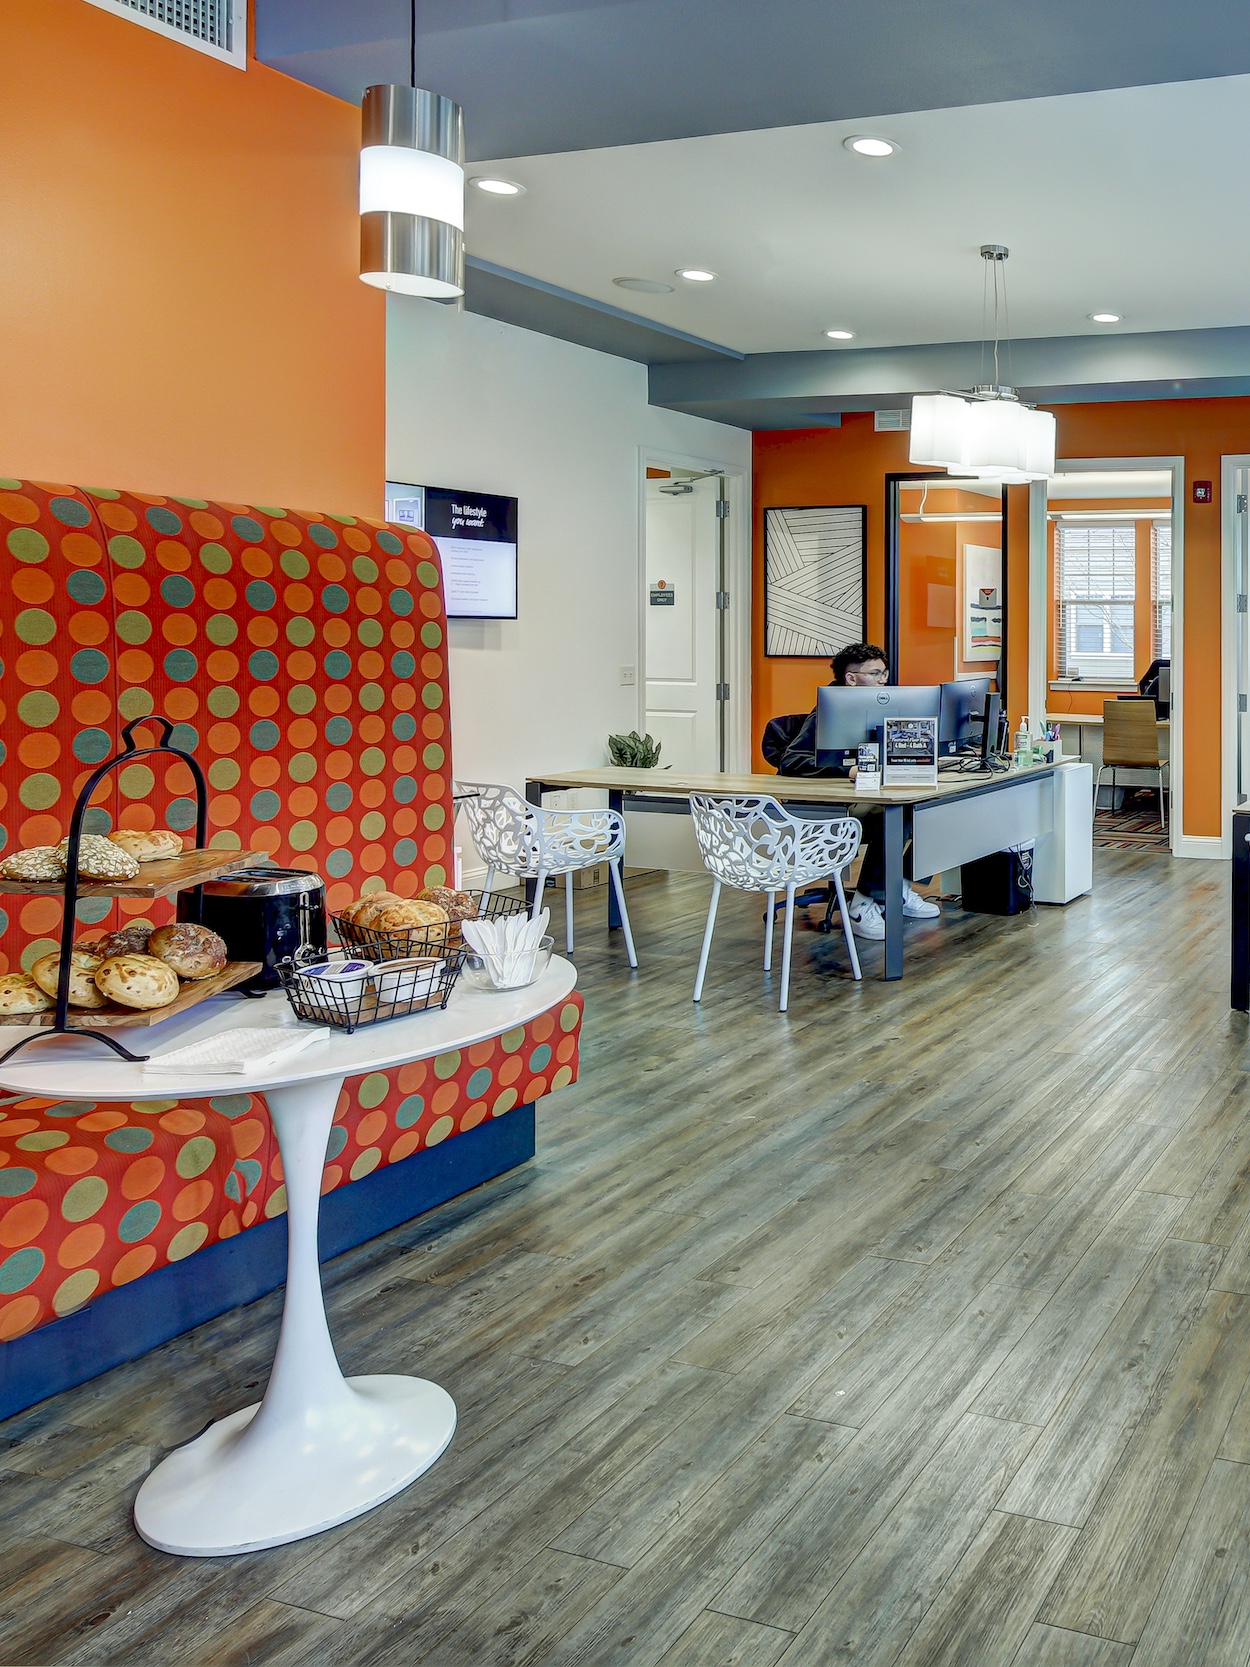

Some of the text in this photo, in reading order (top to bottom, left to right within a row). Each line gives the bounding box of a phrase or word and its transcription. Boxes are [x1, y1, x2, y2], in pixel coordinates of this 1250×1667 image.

[451, 503, 487, 519] The lifestyle
[451, 517, 465, 530] you
